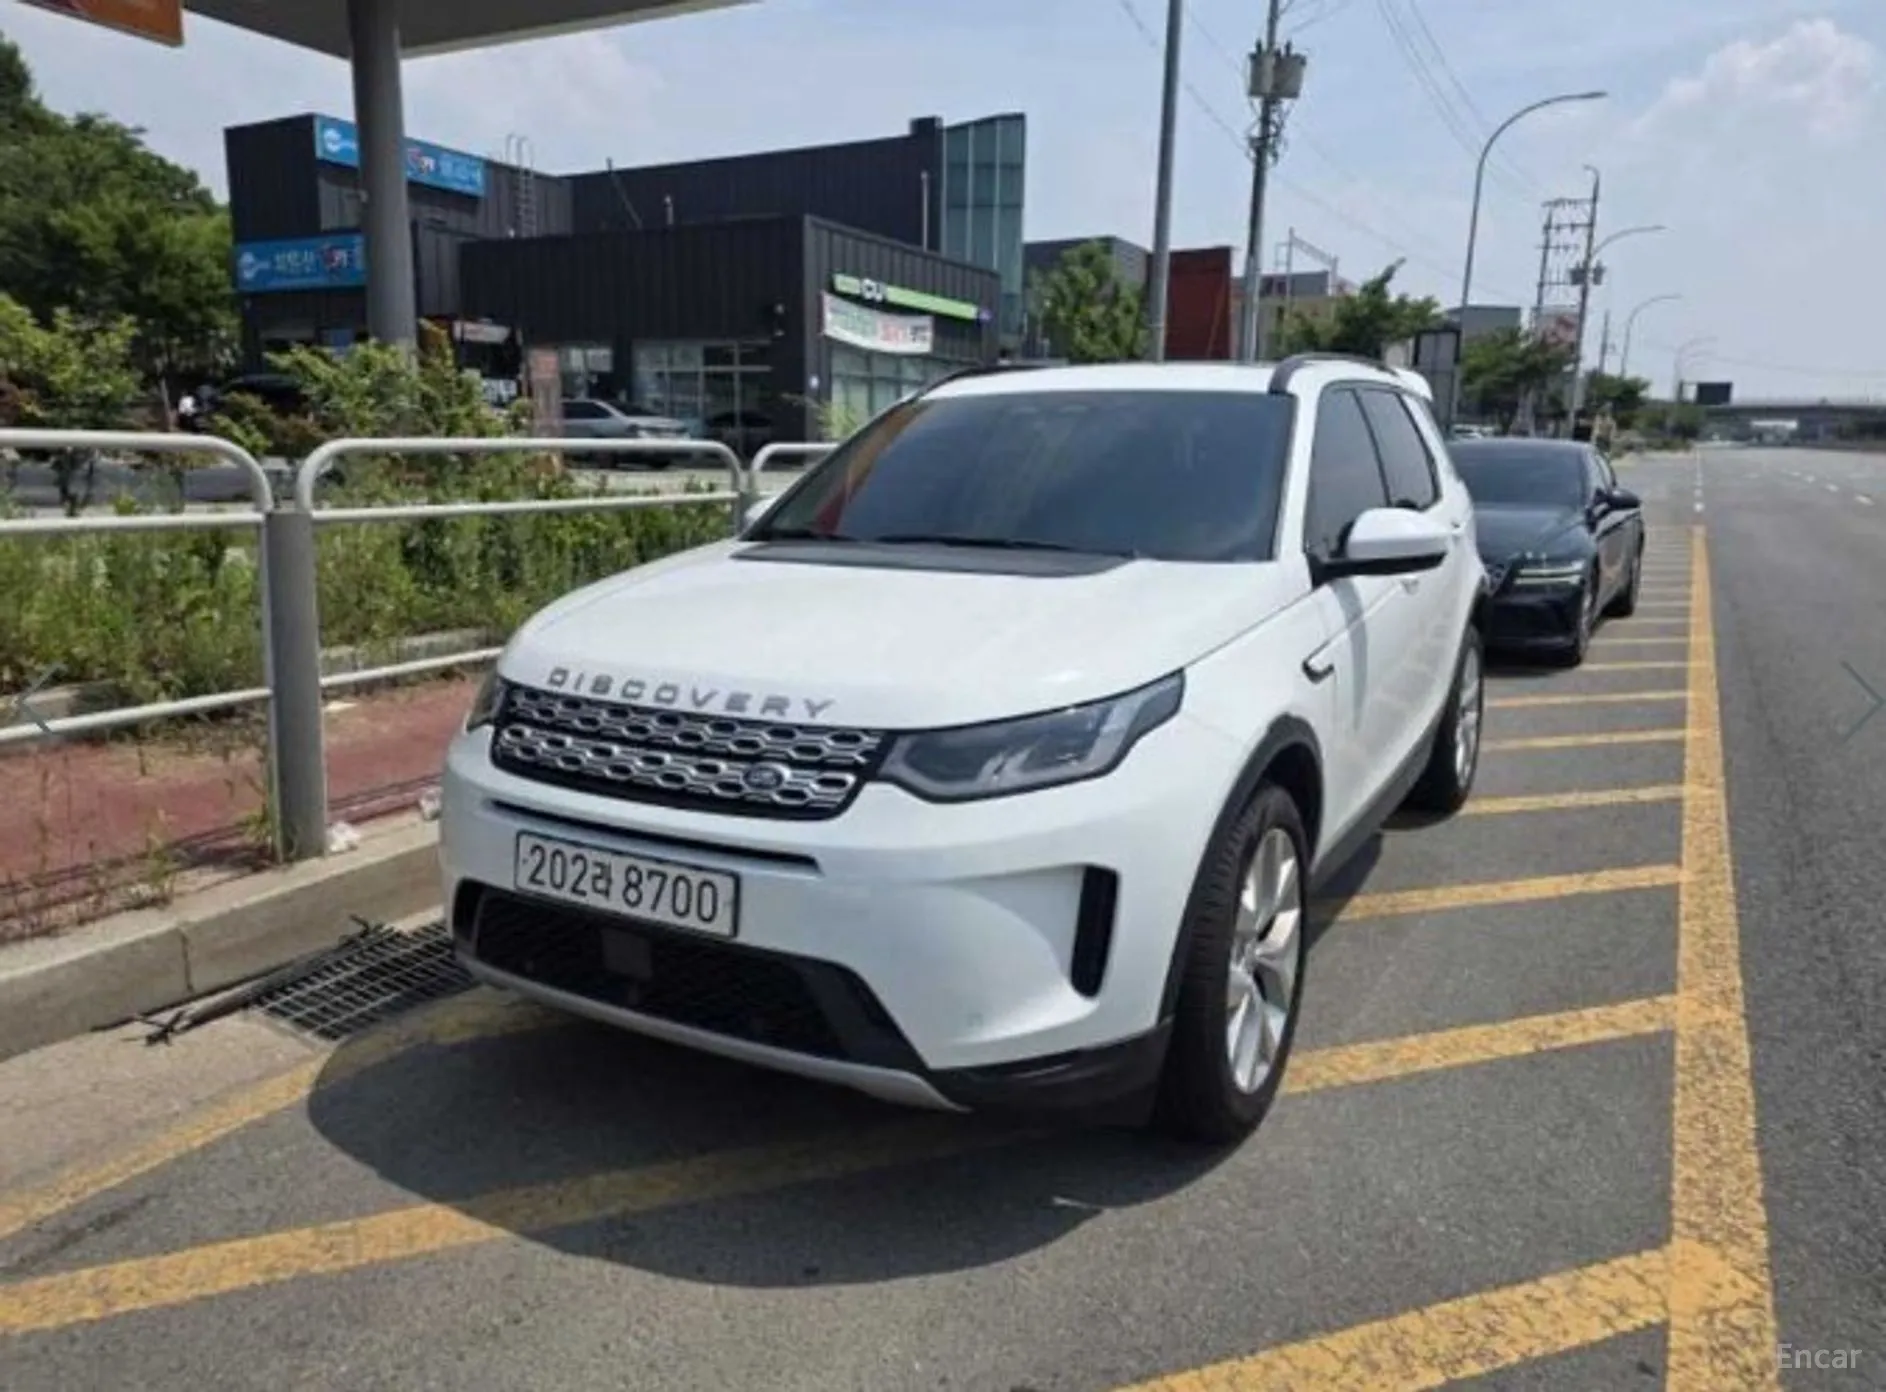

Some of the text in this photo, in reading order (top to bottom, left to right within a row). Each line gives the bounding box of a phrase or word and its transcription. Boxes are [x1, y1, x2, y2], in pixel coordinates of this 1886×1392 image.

[861, 278, 886, 302] CU
[546, 666, 837, 718] DISCOVERY
[526, 843, 720, 924] 202라 8700
